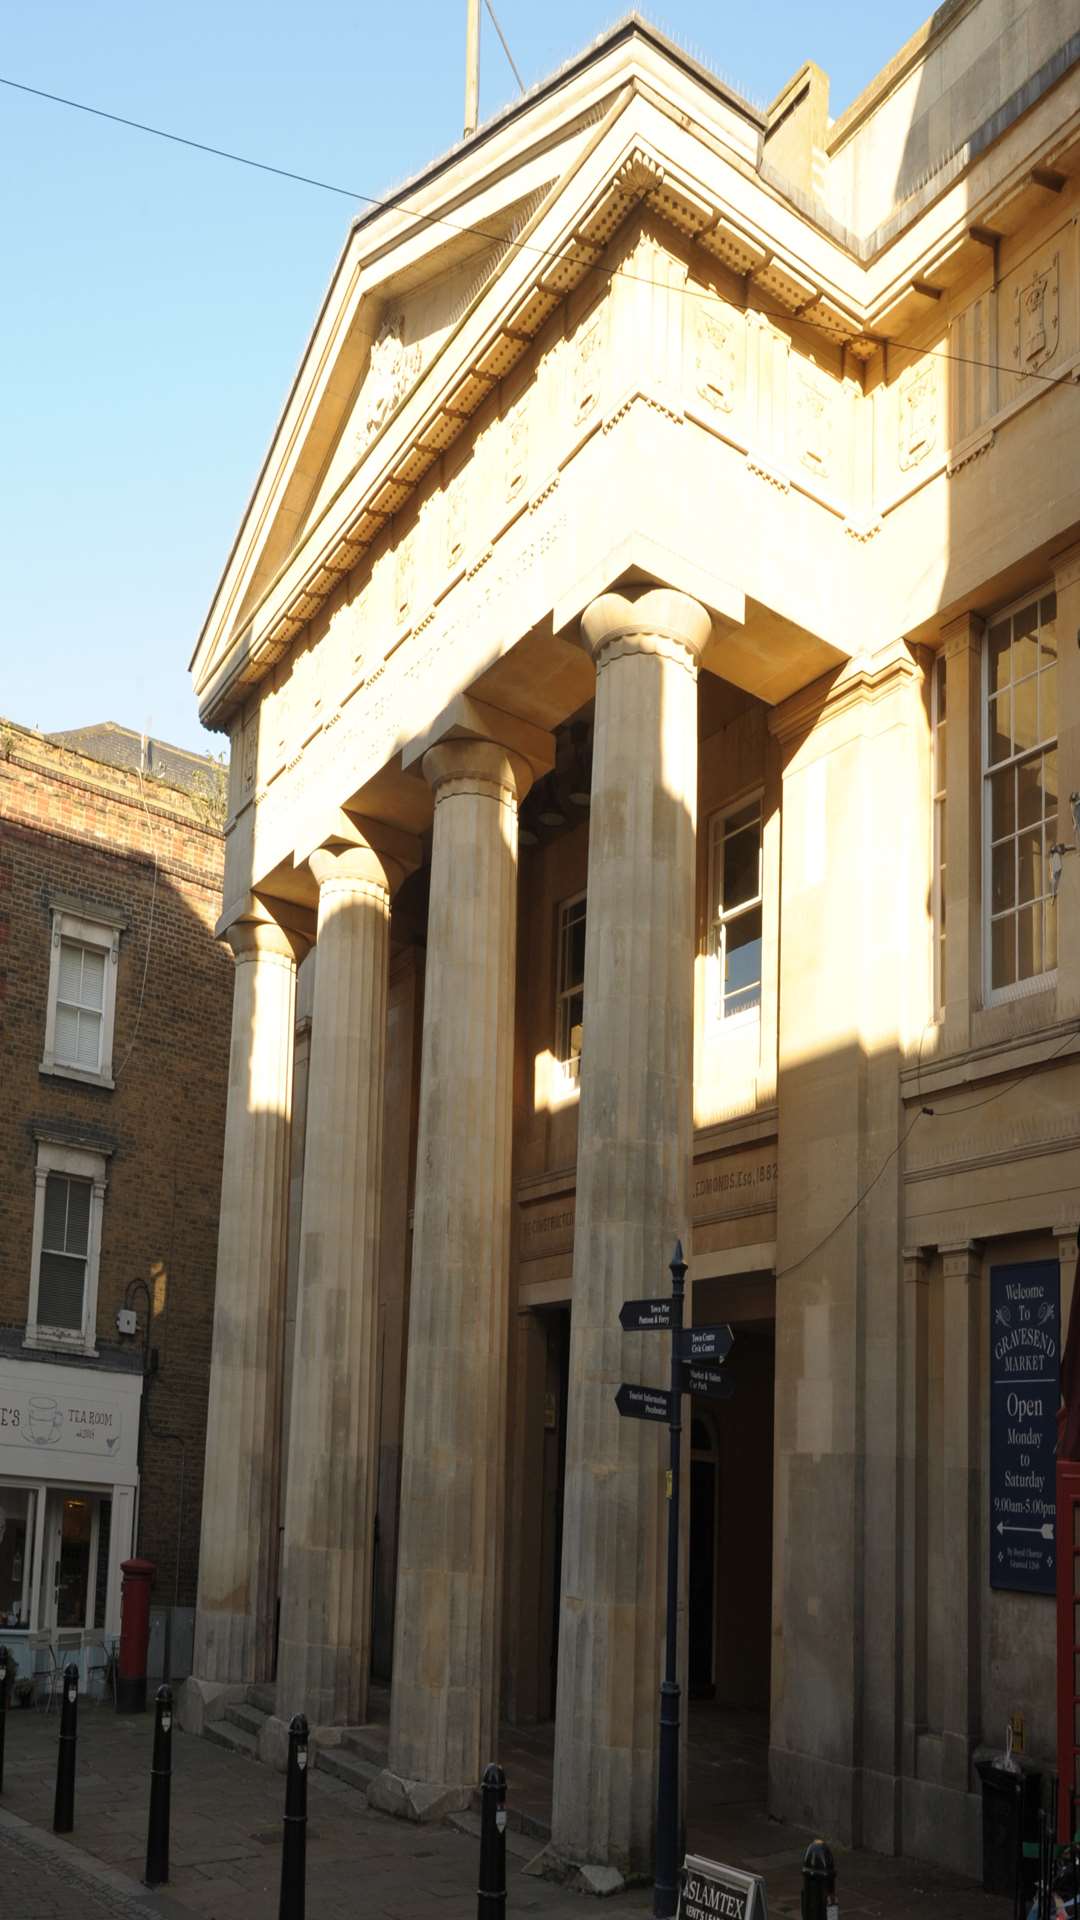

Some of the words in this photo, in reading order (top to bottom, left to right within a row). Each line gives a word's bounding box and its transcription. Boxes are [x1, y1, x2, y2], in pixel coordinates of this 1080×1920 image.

[1005, 1283, 1044, 1300] Welcome
[658, 1314, 670, 1325] Ferry
[1018, 1304, 1030, 1320] To
[995, 1327, 1055, 1360] GRAVESEND
[1005, 1354, 1044, 1372] MARKET
[1007, 1392, 1043, 1423] Open
[68, 1409, 87, 1424] TEA
[88, 1411, 113, 1427] ROOM
[1007, 1426, 1043, 1448] Monday
[1020, 1454, 1030, 1467] to
[1004, 1470, 1045, 1493] Saturday
